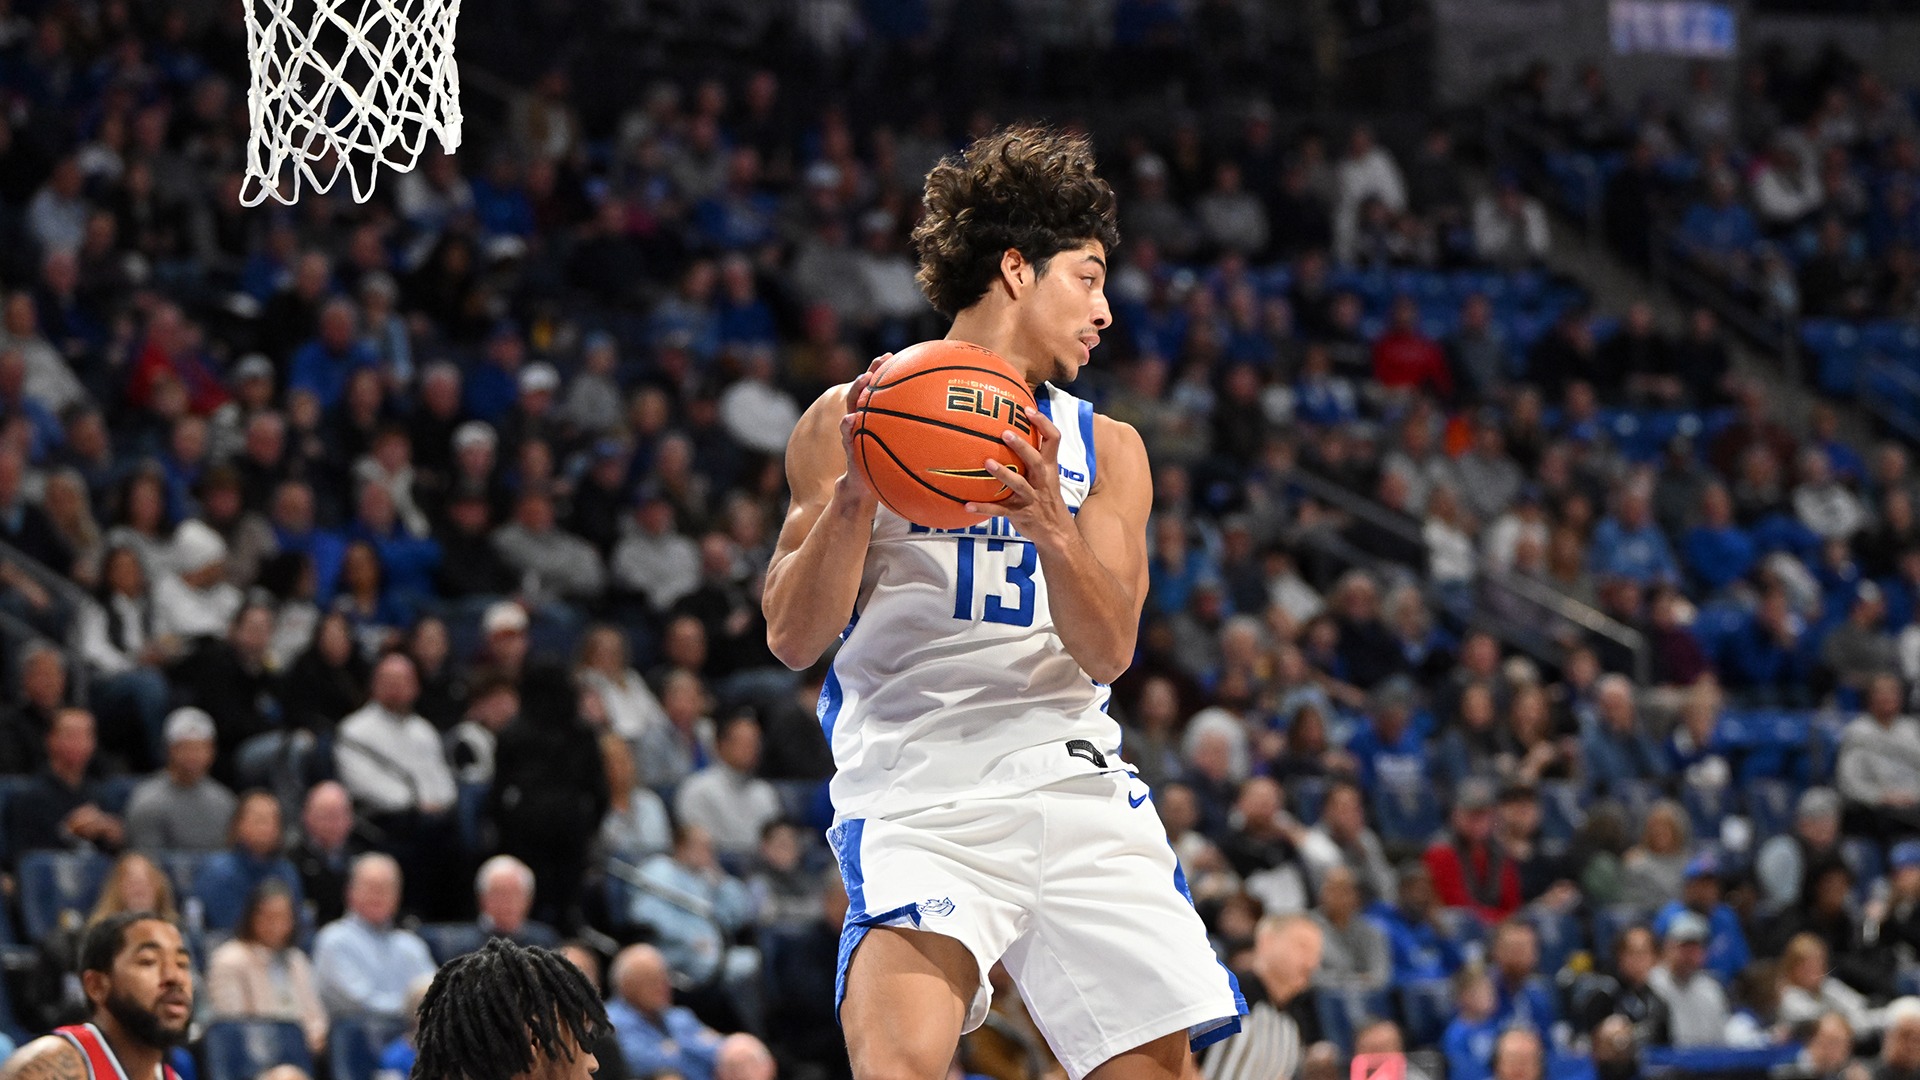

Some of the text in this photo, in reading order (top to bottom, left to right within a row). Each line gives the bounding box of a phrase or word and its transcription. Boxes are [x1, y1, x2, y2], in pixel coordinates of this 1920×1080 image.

[946, 386, 1031, 435] ELITE
[948, 379, 1020, 401] MPIONSHIP
[953, 537, 1038, 627] 13
